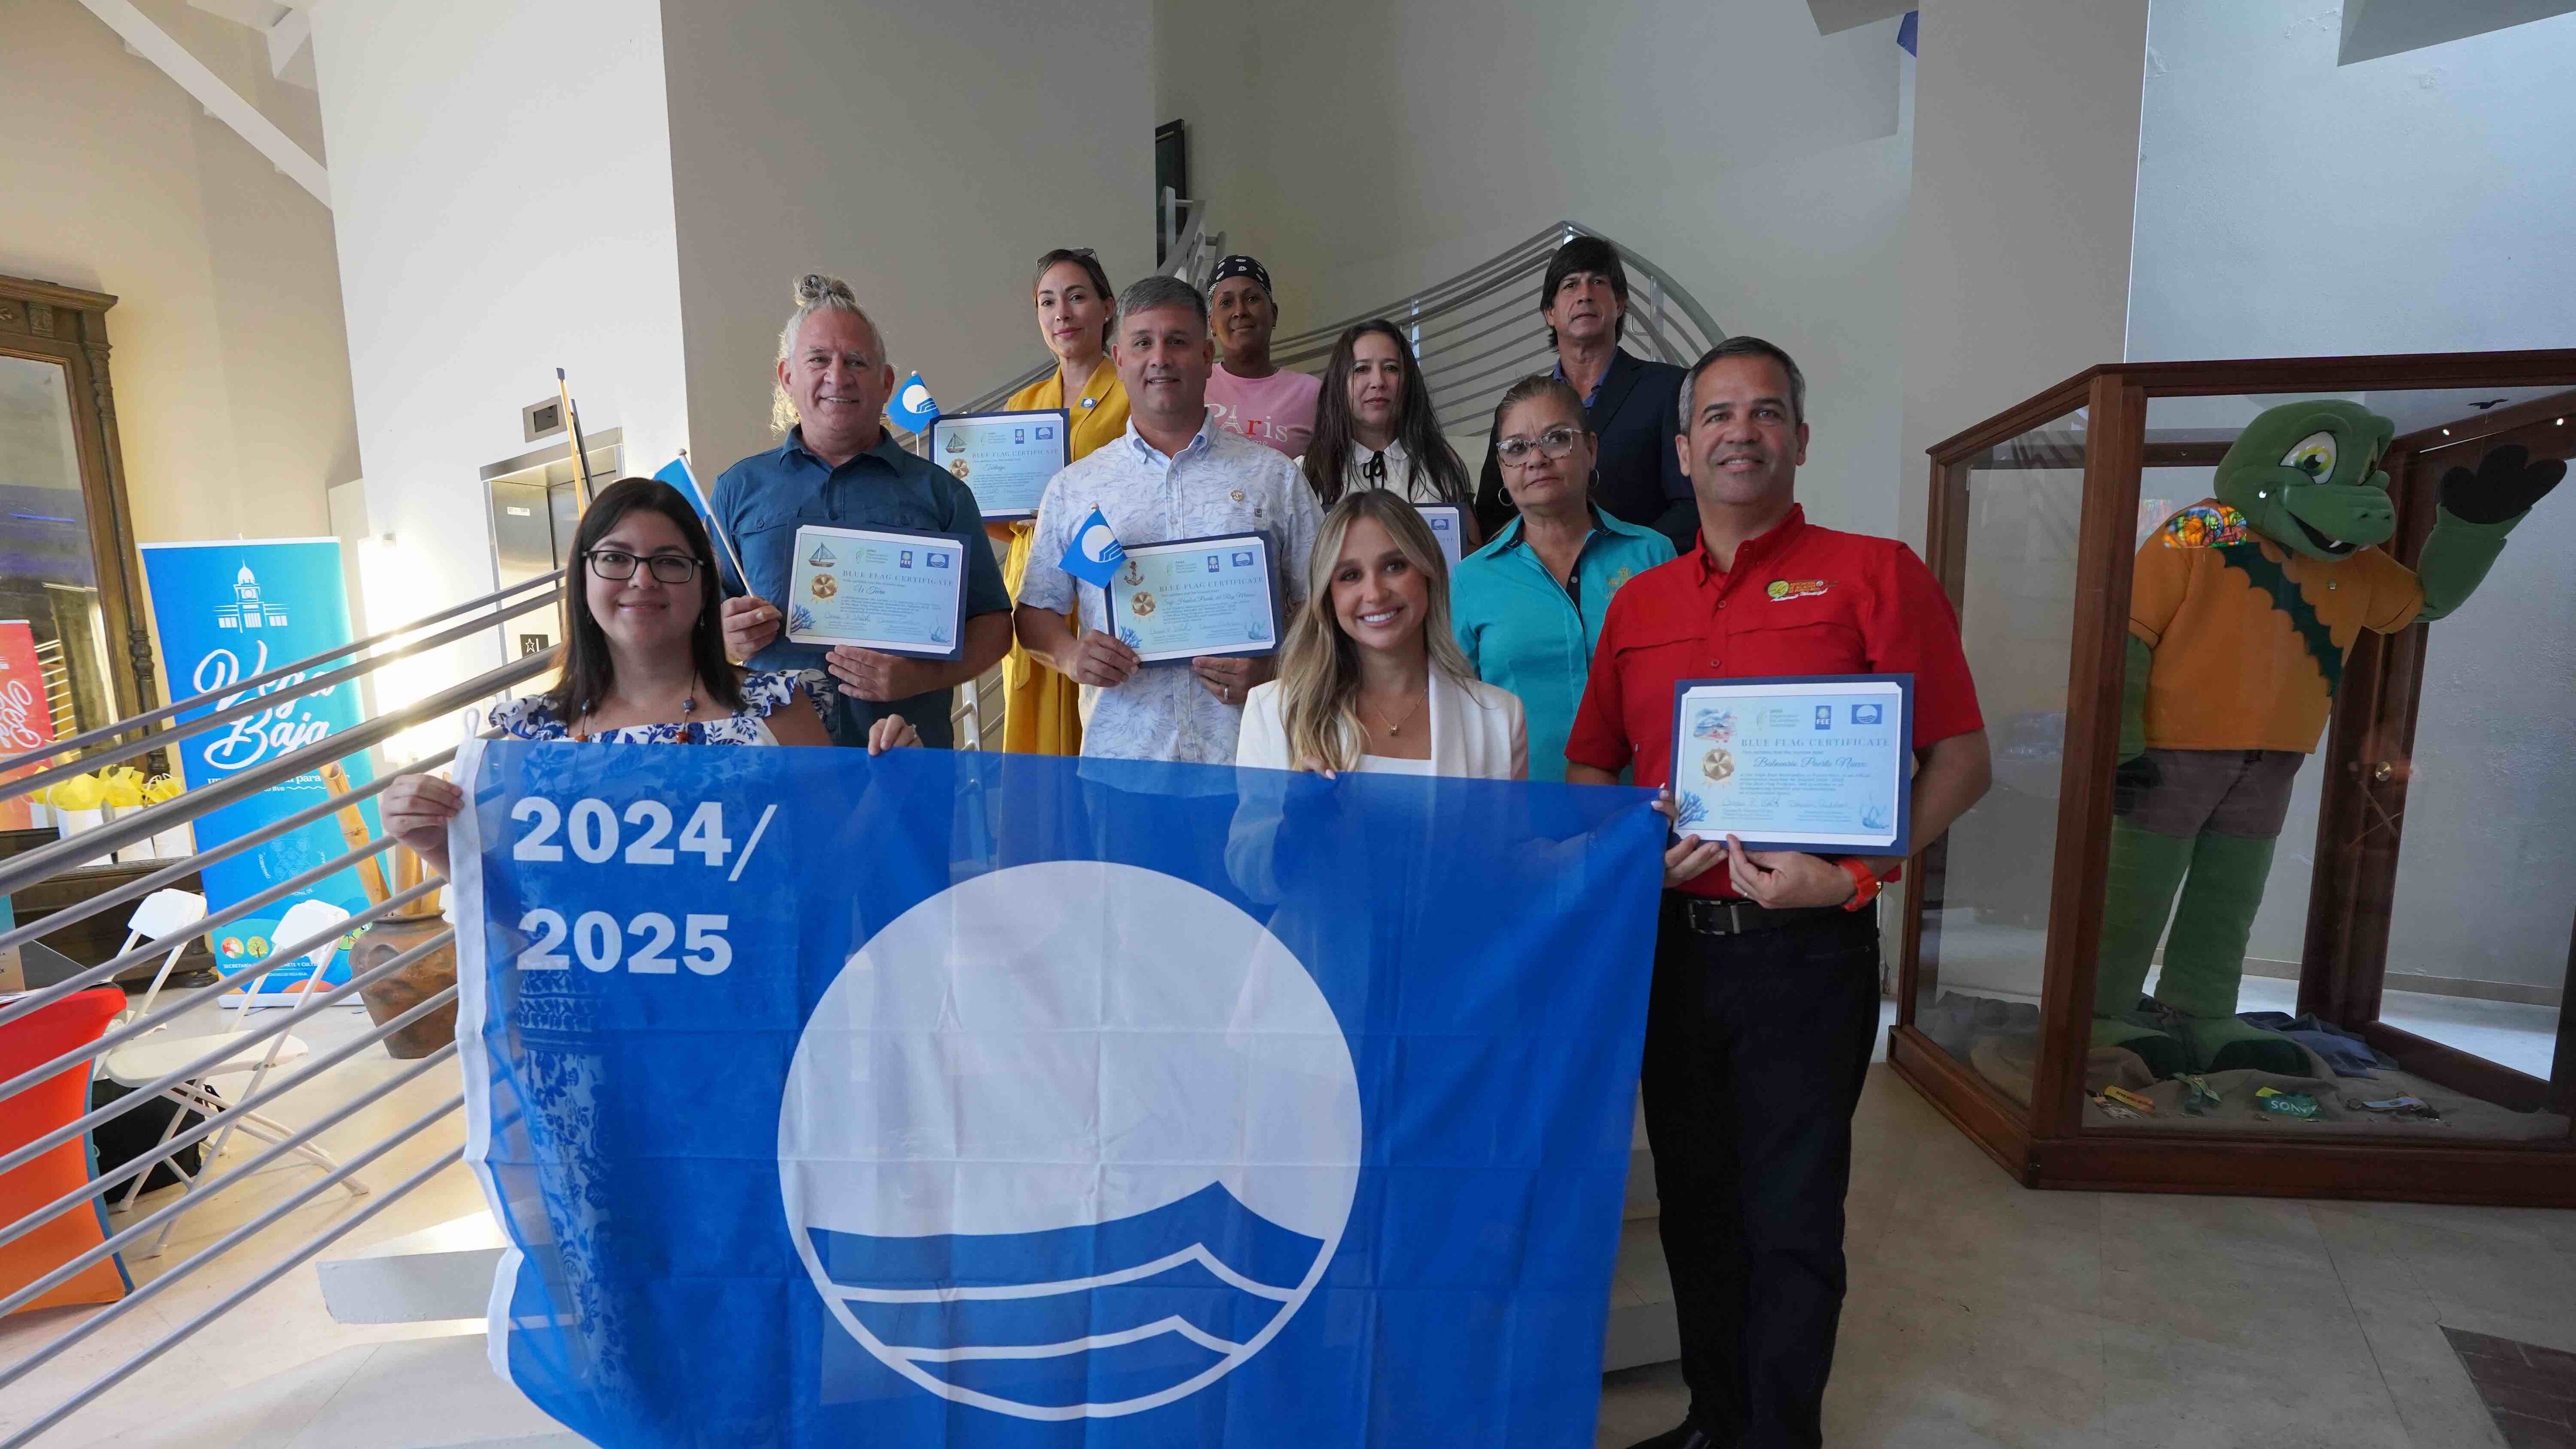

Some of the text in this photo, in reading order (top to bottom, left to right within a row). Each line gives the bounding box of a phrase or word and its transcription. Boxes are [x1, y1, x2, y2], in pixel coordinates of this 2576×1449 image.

[894, 575, 953, 587] CERTIFICATE
[1208, 576, 1262, 589] CERTIFICATE
[204, 698, 332, 769] Baja
[1741, 738, 1890, 747] BLUE FLAG CERTIFICATE
[296, 775, 321, 784] para
[511, 796, 777, 881] 2024/
[517, 908, 732, 975] 2025
